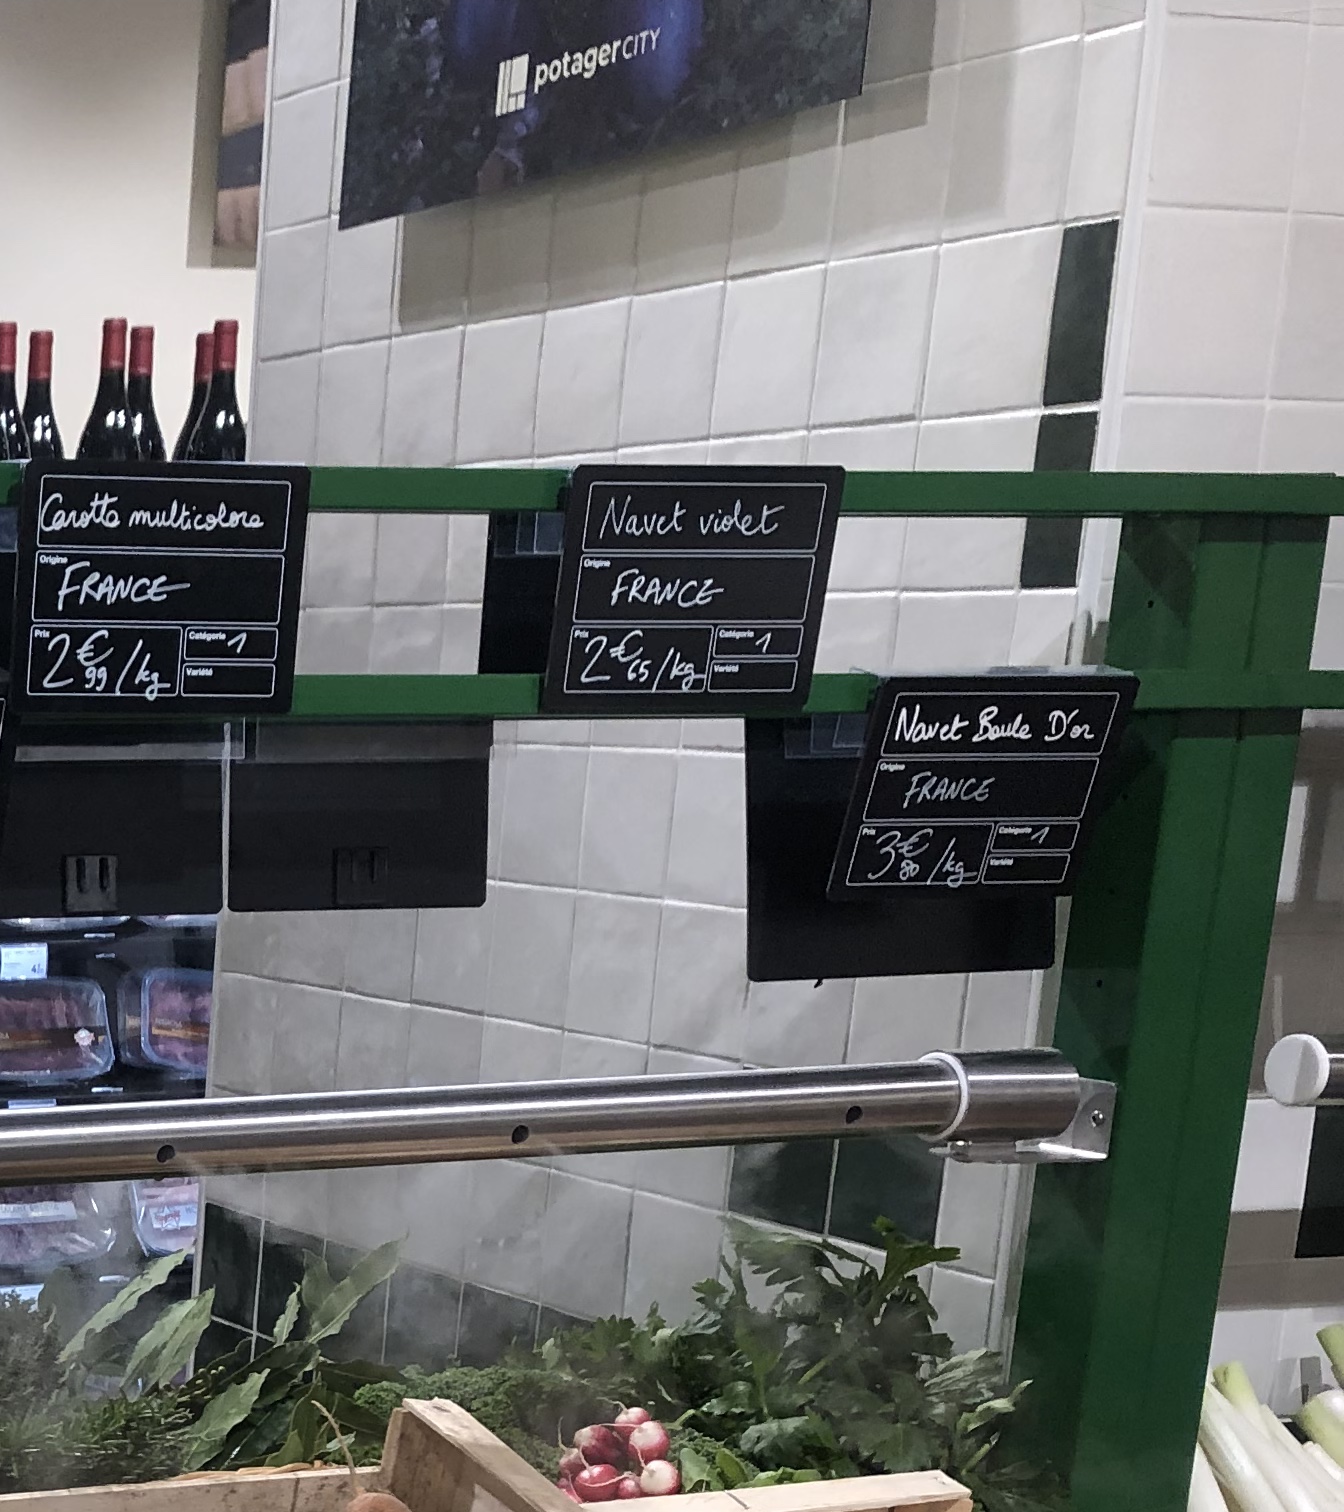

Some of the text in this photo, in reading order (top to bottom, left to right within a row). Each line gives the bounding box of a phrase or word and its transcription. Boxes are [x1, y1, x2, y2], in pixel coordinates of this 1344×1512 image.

[534, 27, 661, 94] potagerCITY
[41, 492, 264, 532] Carotte multicolore
[600, 494, 785, 539] Navet violet
[40, 555, 68, 565] Origine
[58, 561, 191, 611] FRANCE
[611, 569, 724, 608] FRANCE
[189, 631, 247, 653] Catégorie 1
[755, 633, 772, 653] 1
[894, 704, 969, 743] Navet
[903, 771, 996, 809] FRANCE
[1031, 826, 1050, 844] 1
